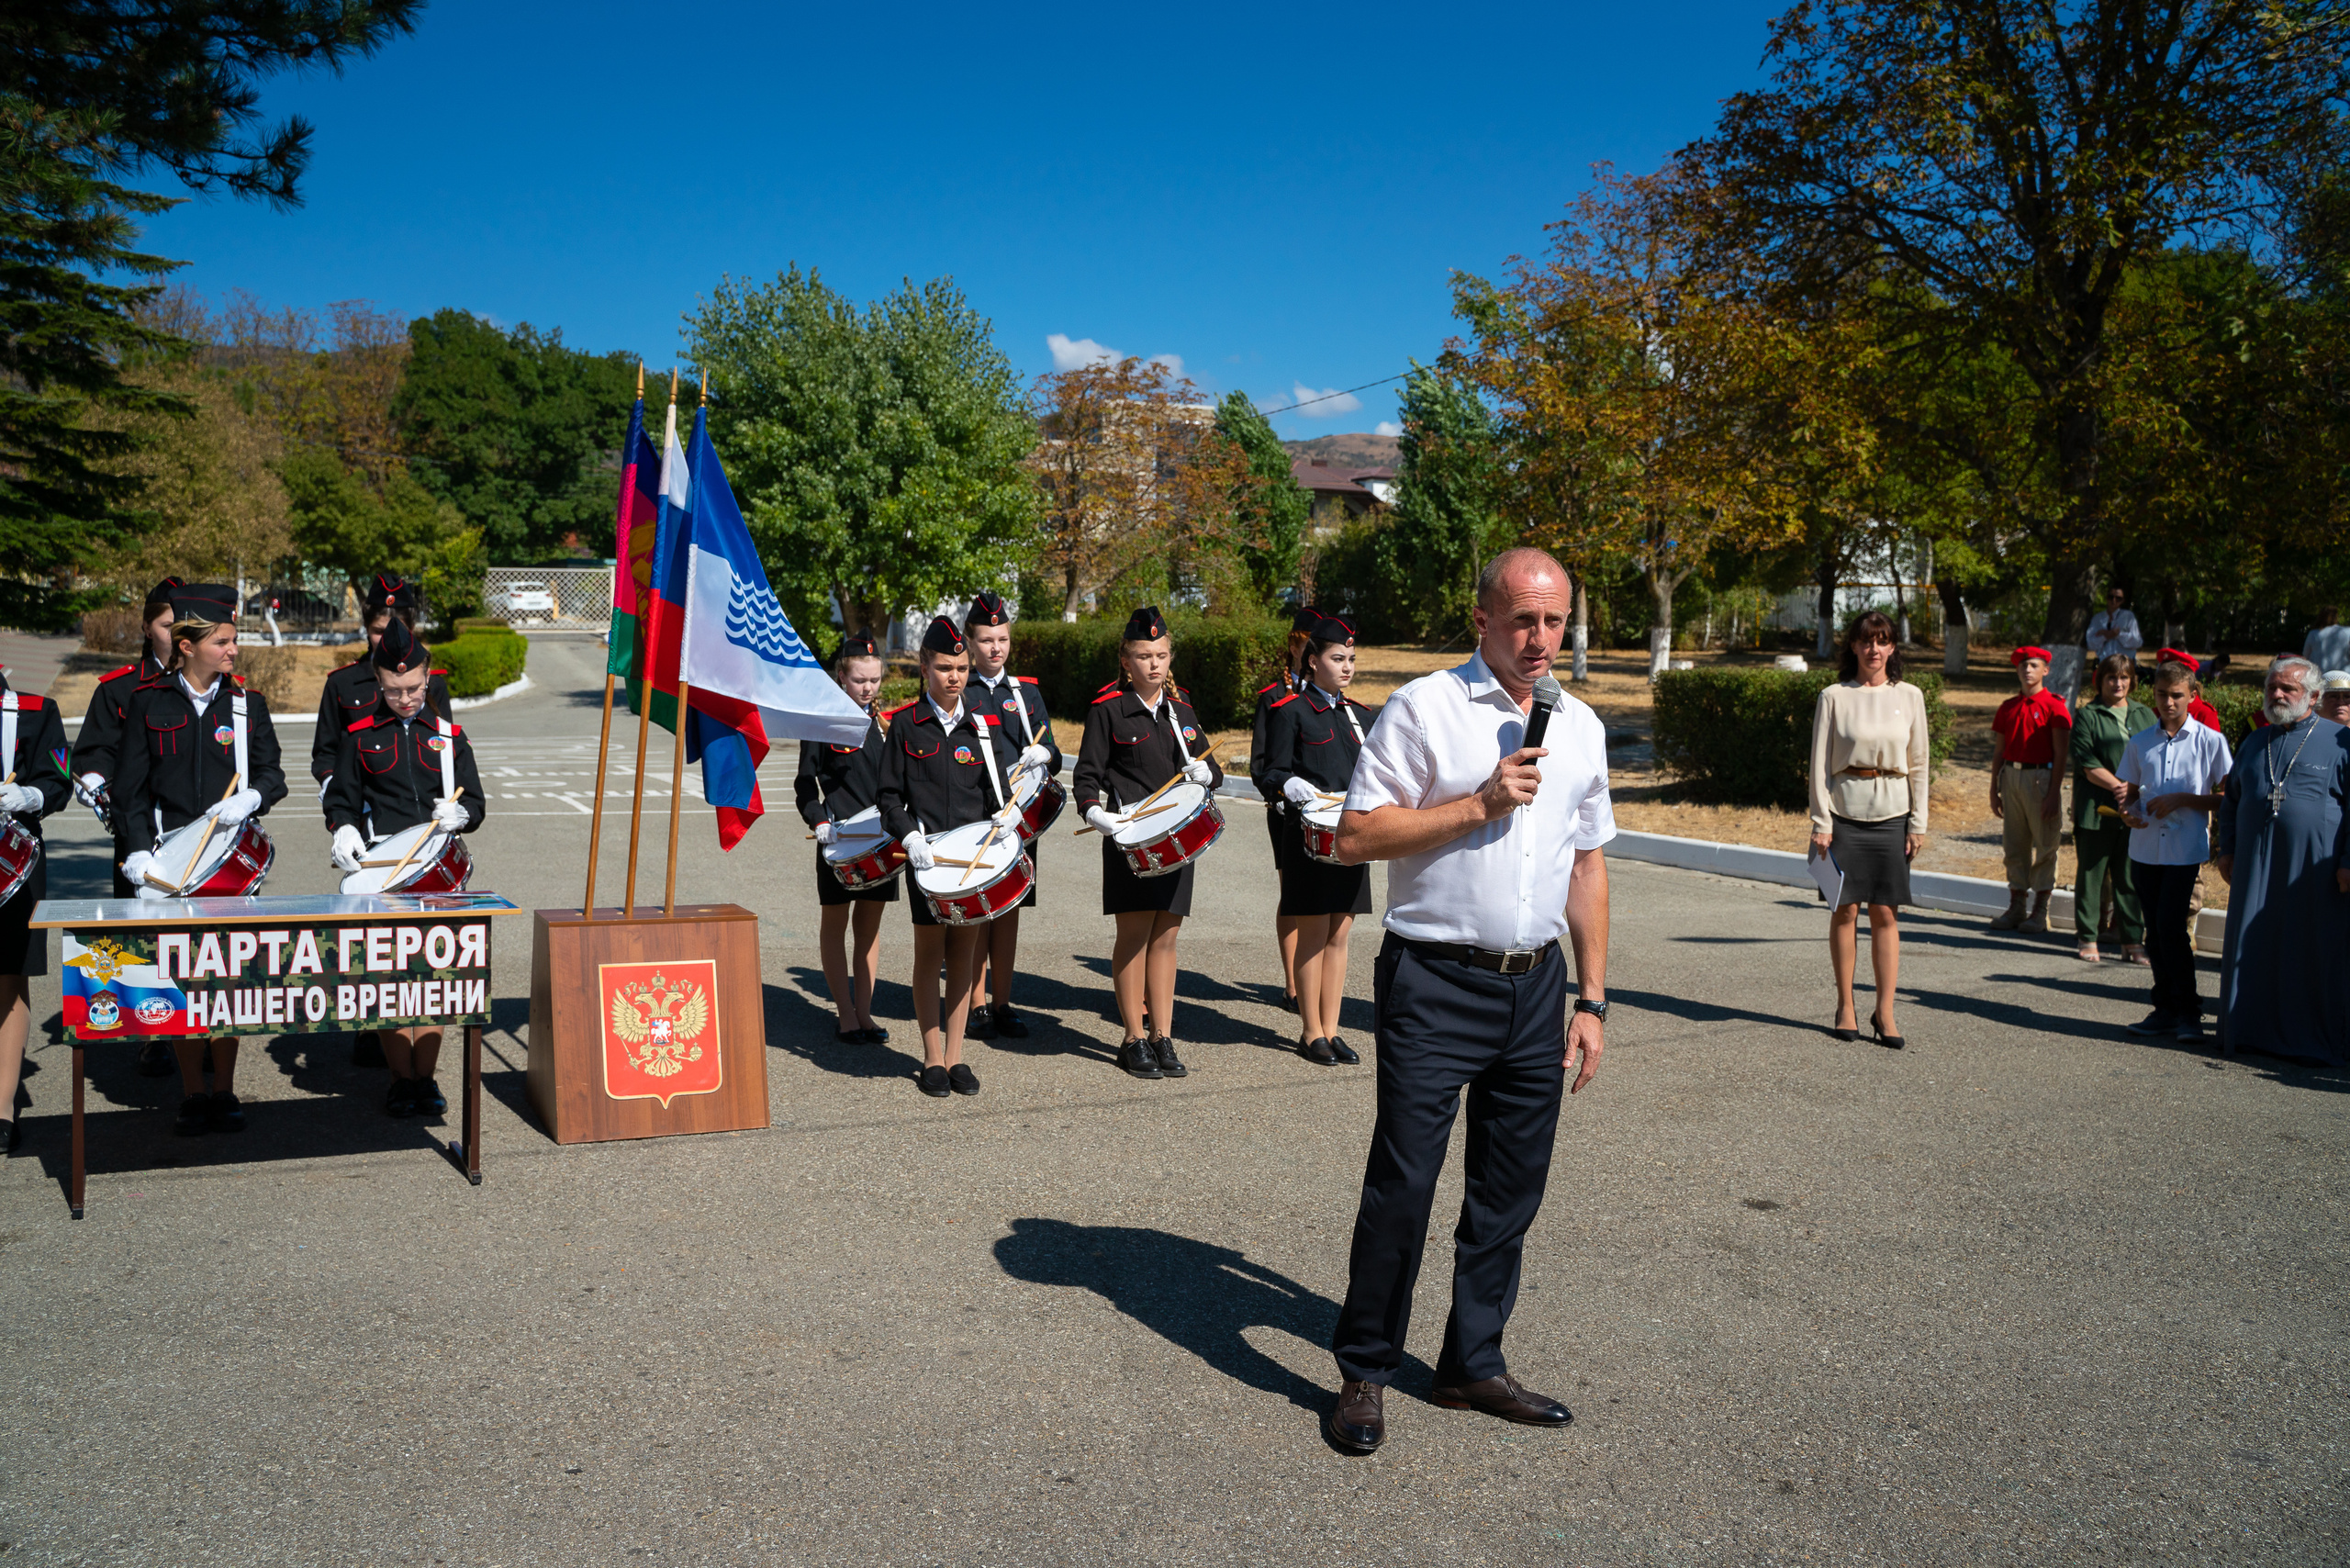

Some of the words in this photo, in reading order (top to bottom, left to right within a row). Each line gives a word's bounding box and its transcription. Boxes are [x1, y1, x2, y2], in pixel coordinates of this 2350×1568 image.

[158, 929, 323, 980] ПАРТА
[339, 924, 486, 973] ГЕРОЯ
[186, 985, 327, 1027] НАШЕГО
[337, 979, 485, 1021] ВРЕМЕНИ
